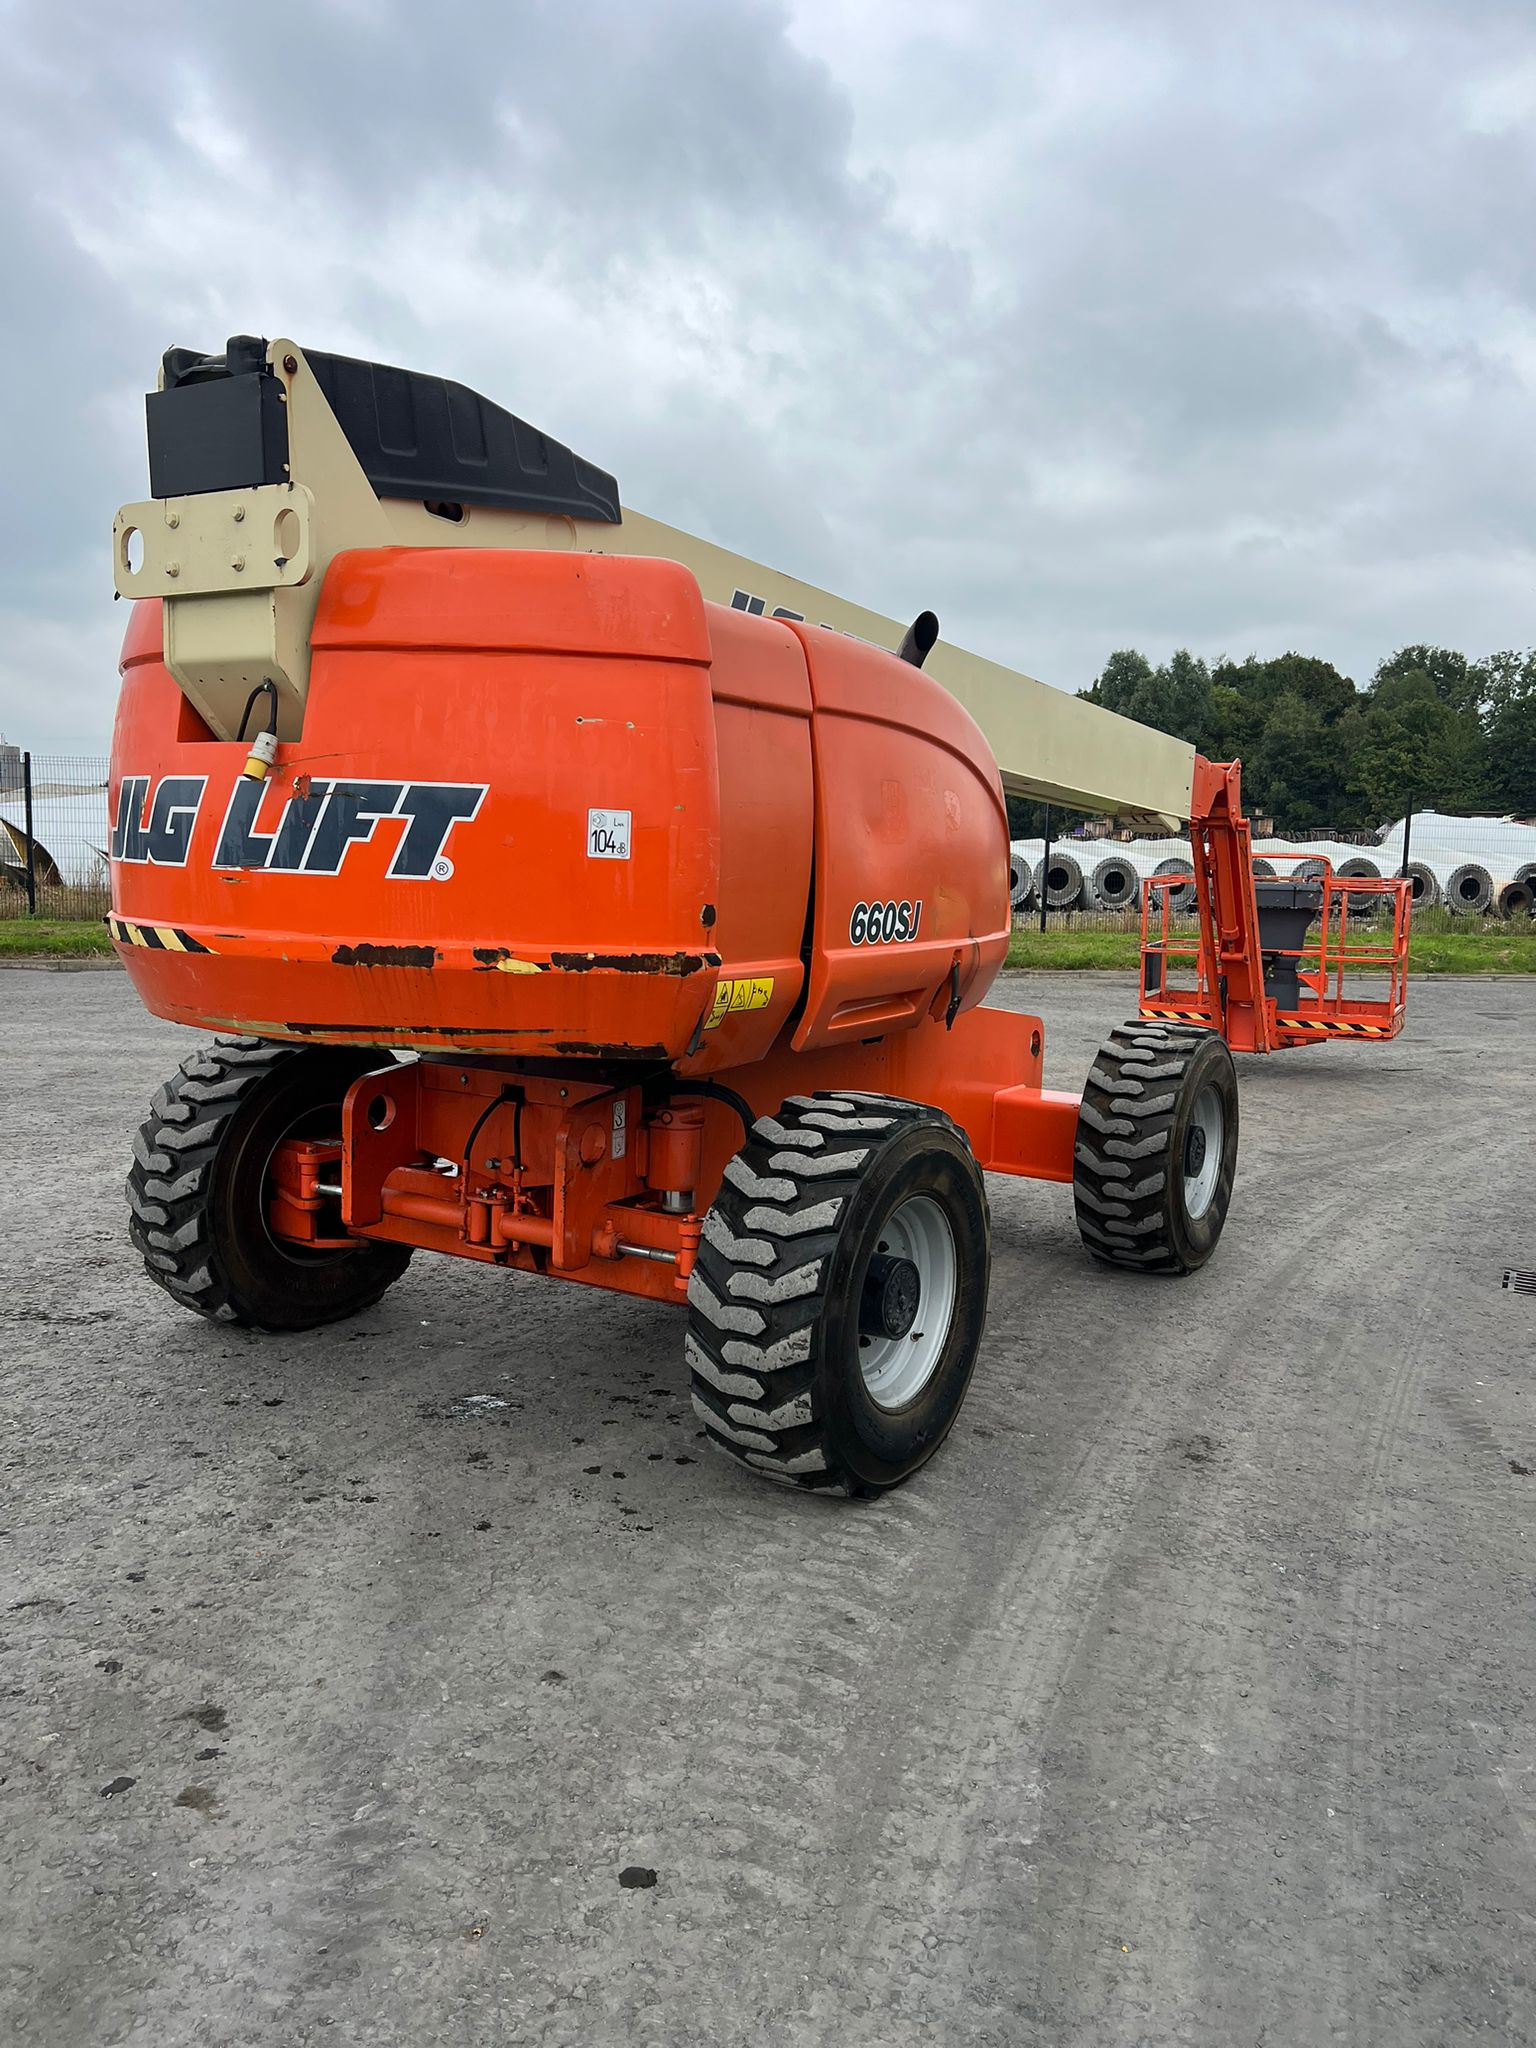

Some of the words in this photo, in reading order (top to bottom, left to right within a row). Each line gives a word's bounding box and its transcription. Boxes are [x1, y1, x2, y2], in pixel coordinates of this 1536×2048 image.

[112, 775, 209, 868] JLG
[211, 775, 490, 880] LIFT
[591, 829, 616, 854] 104
[849, 900, 923, 946] 660SJ
